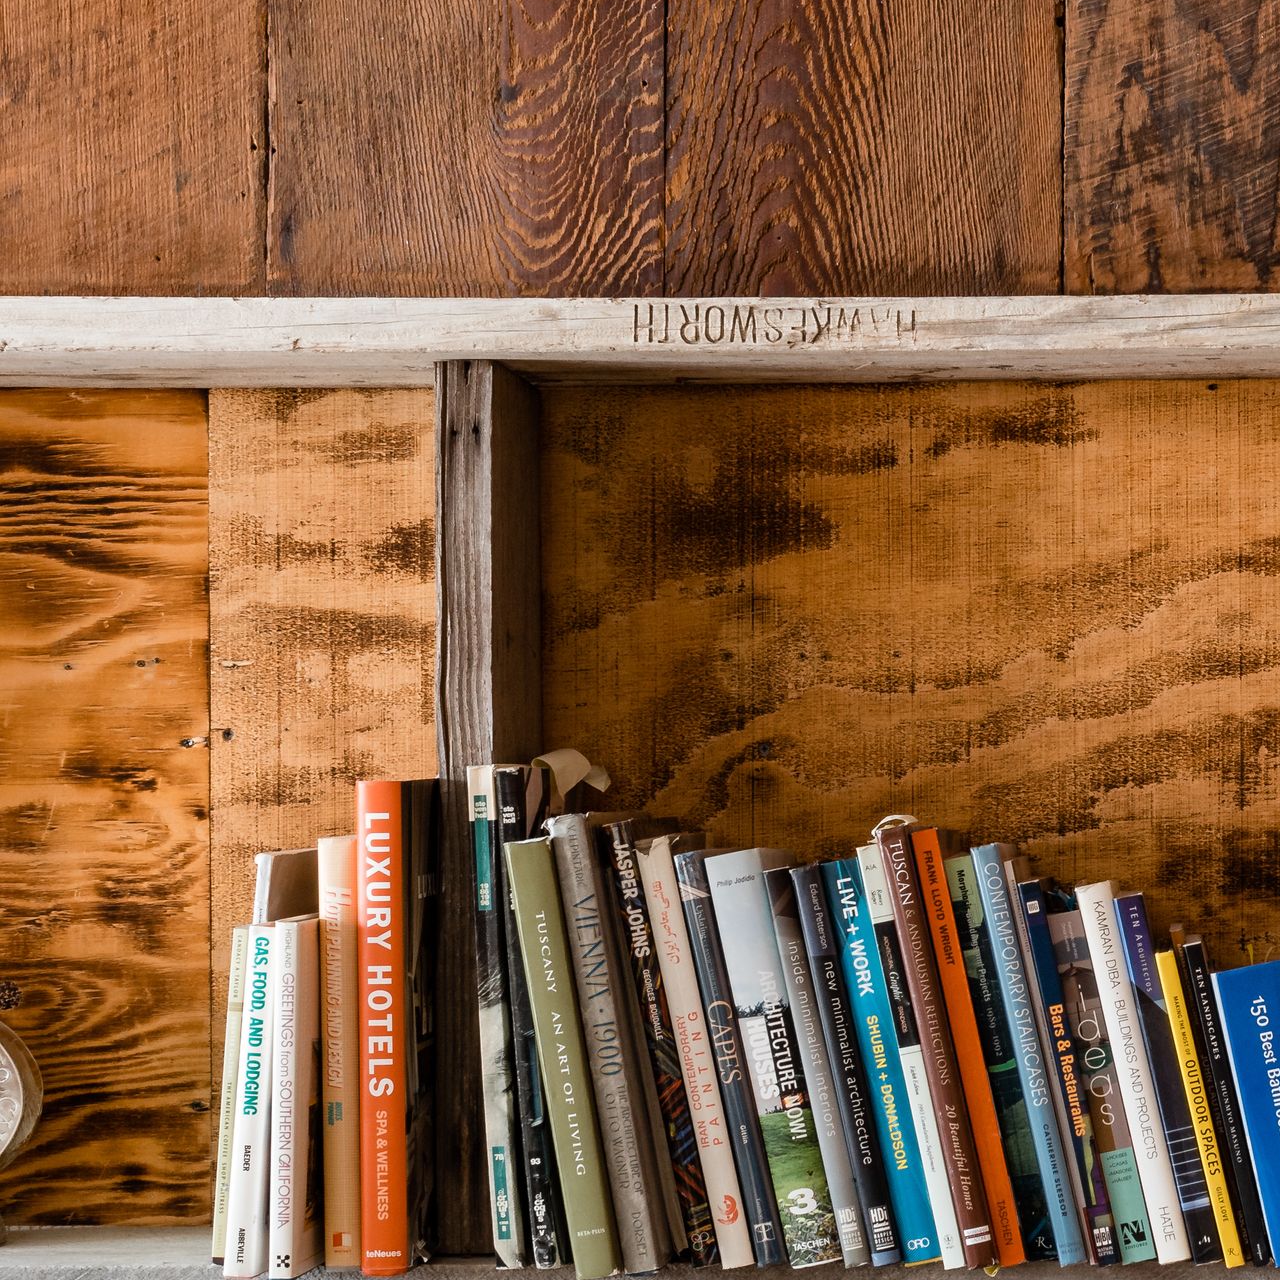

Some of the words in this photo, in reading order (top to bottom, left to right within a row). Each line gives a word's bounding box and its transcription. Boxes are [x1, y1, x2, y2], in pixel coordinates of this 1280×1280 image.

[634, 303, 917, 345] HAWKESWORTH
[365, 813, 391, 950] LUXURY
[717, 879, 733, 888] Philip
[734, 874, 756, 884] Jodidio
[890, 840, 913, 906] TUSCAN
[613, 842, 638, 899] JASPER
[627, 907, 650, 958] JOHNS
[837, 877, 858, 920] LIVE
[906, 909, 915, 919] &
[923, 850, 938, 885] FRANK
[931, 888, 945, 919] LLOYD
[939, 924, 955, 966] WRIGHT
[284, 929, 294, 969] HIGHLAND
[847, 924, 859, 935] +
[1093, 900, 1113, 955] KAMRAN
[252, 937, 269, 968] GAS,
[536, 911, 557, 993] TUSCANY
[850, 939, 874, 997] WORK
[909, 923, 932, 1001] ANDALUSIAN
[1105, 958, 1120, 989] DIBA
[251, 972, 267, 1012] FOOD,
[643, 970, 655, 1001] GEORGES
[649, 1004, 663, 1040] BOUDAILLE
[984, 862, 1026, 1005] CONTEMPORARY
[1015, 1008, 1048, 1107] STAIRCASES
[281, 972, 294, 1048] GREETINGS
[368, 965, 394, 1097] HOTELS
[551, 1012, 563, 1035] AN
[1115, 999, 1137, 1063] BUILDINGS
[1250, 995, 1269, 1027] 150
[250, 1017, 264, 1047] AND
[788, 941, 805, 985] inside
[798, 992, 822, 1066] minimalist
[815, 1072, 836, 1137] interiors
[925, 1005, 950, 1086] REFLECTIONS
[1259, 1030, 1275, 1065] Best
[280, 1051, 290, 1076] from
[557, 1043, 570, 1075] ART
[676, 1016, 702, 1111] CONTEMPORARY
[747, 1018, 780, 1100] HOUSES
[824, 961, 837, 991] new
[832, 997, 854, 1071] minimalist
[847, 1076, 872, 1165] architecture
[1129, 1068, 1143, 1093] AND
[243, 1052, 261, 1116] LODGING
[564, 1083, 574, 1105] OF
[279, 1080, 294, 1150] SOUTHERN
[376, 1111, 387, 1137] SPA
[700, 1121, 710, 1148] IRAN
[1135, 1096, 1158, 1160] PROJECTS
[243, 1145, 251, 1172] BAEDER
[377, 1139, 388, 1148] &
[568, 1113, 585, 1176] LIVING
[277, 1153, 291, 1229] CALIFORNIA
[377, 1149, 389, 1220] WELLNESS
[1043, 1124, 1058, 1175] CATHERINE
[1055, 1178, 1068, 1217] SLESSOR
[787, 1188, 818, 1215] 3
[998, 1200, 1013, 1246] TASCHEN
[1221, 1208, 1229, 1222] LOVE
[793, 1238, 830, 1252] TASCHEN
[1159, 1206, 1176, 1241] HATJE
[237, 1228, 246, 1263] ABBEVILLE
[366, 1250, 401, 1258] teNeues
